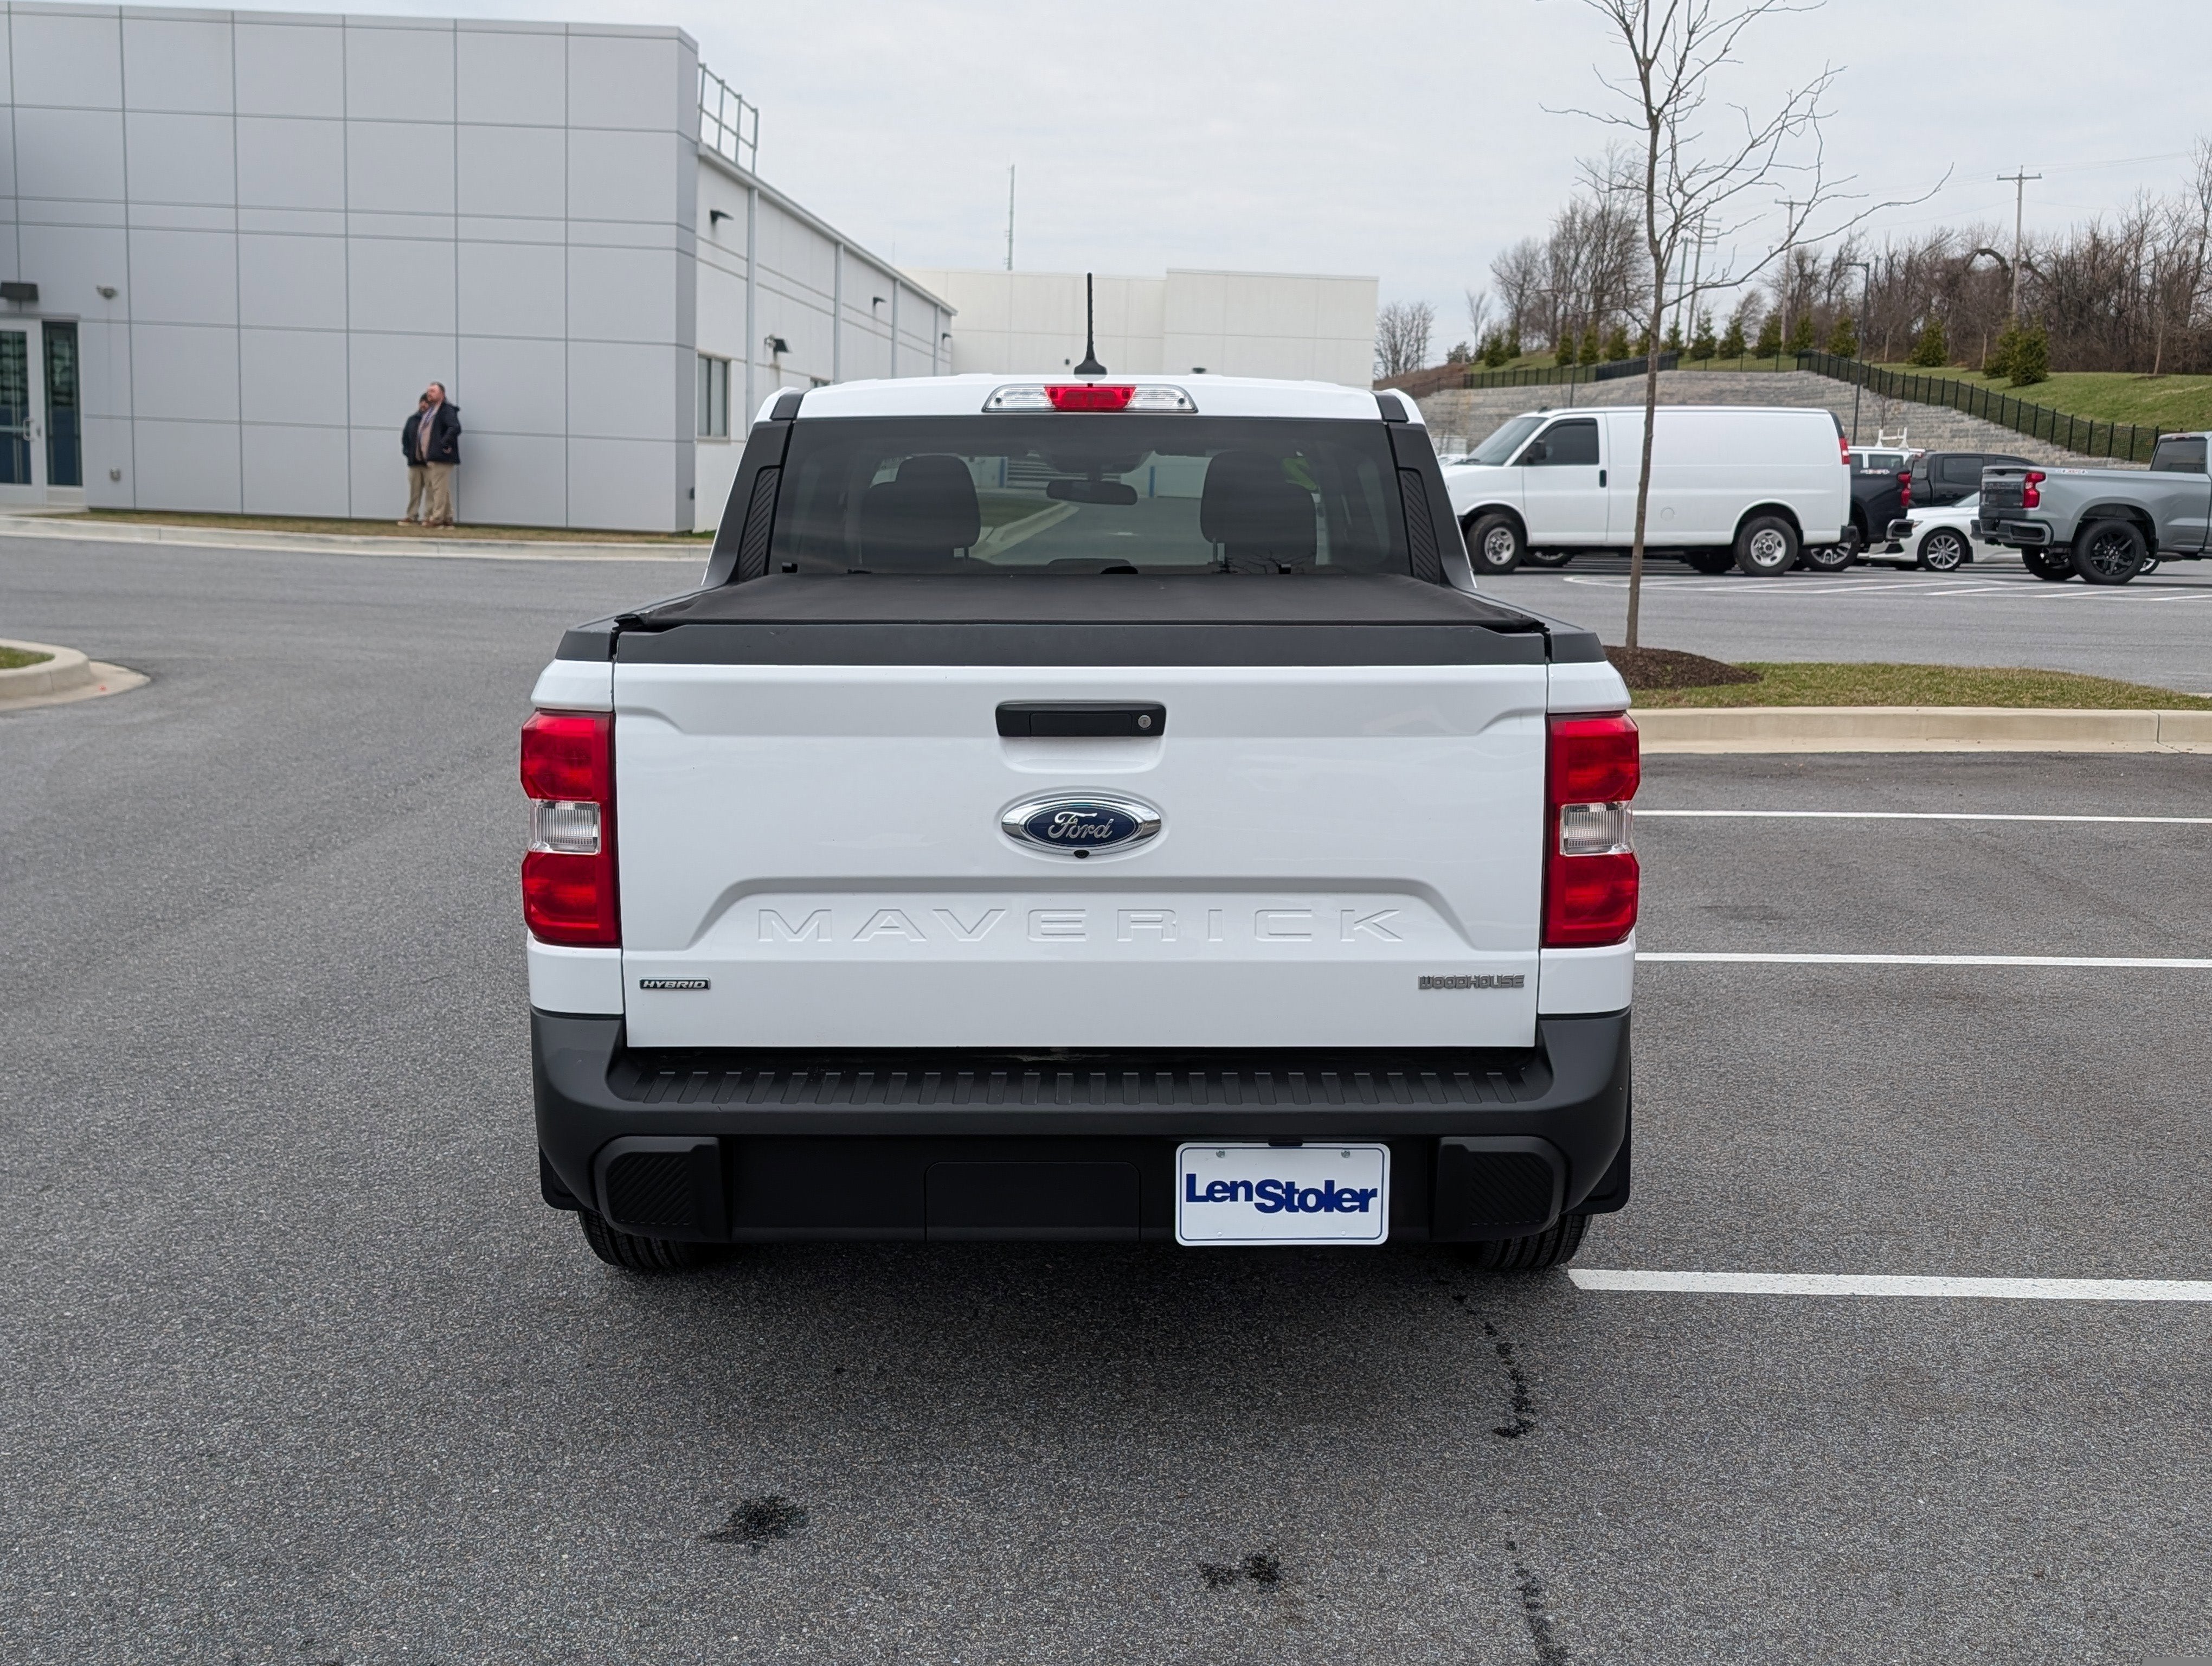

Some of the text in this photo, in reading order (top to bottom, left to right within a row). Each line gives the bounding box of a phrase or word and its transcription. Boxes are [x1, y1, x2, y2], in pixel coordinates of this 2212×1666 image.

[1047, 811, 1114, 838] Ford
[758, 908, 1403, 942] MAVERICK
[1418, 975, 1525, 989] WOODHOUSE
